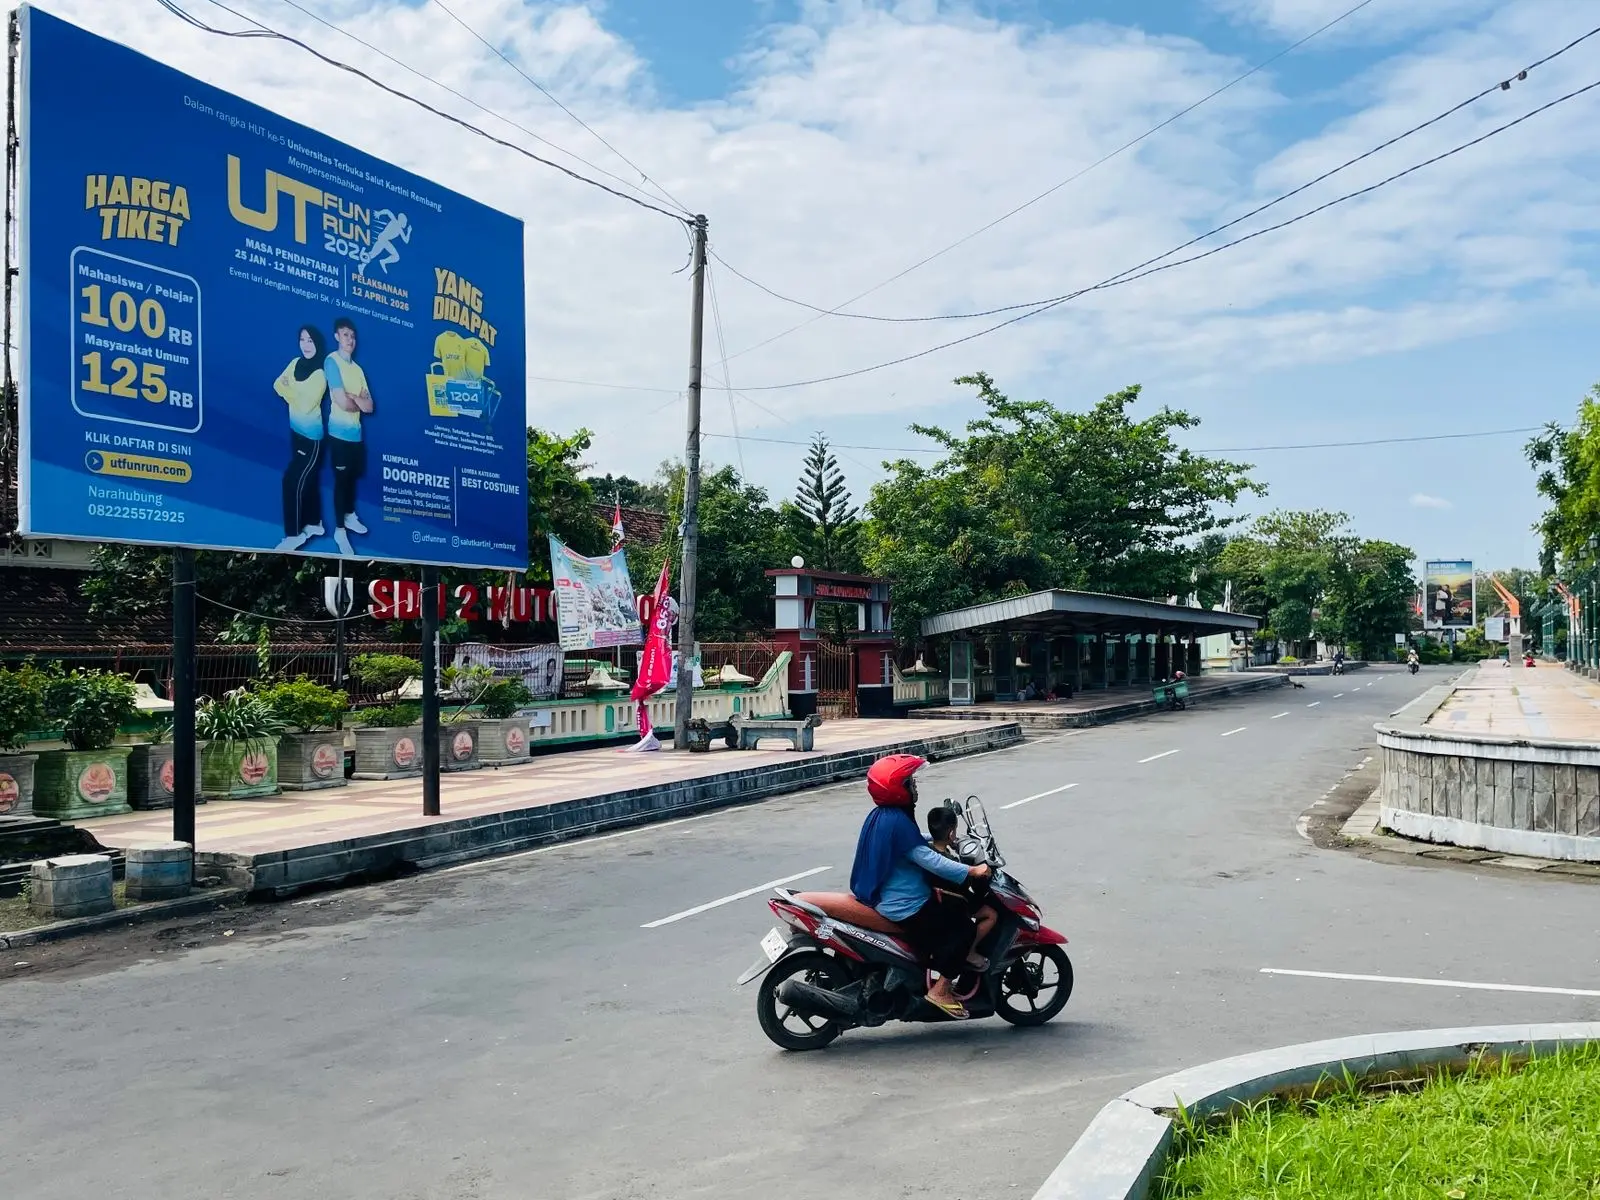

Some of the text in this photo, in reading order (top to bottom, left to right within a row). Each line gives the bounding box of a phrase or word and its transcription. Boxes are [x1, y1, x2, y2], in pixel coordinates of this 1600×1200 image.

[184, 96, 442, 213] Dalam rangka HUT ke-5 Universitas Terbuka Salut Kartini Rembang
[288, 155, 364, 195] Mempersembahkan
[85, 174, 191, 221] HARGA
[227, 153, 323, 245] UT
[323, 192, 371, 226] FUN
[99, 207, 184, 247] TIKET
[322, 213, 371, 246] RUN
[245, 238, 339, 276] MASA PENDAFTARAN
[323, 233, 371, 265] 2026
[78, 264, 194, 304] Mahasiswa / Pelajar
[229, 266, 250, 280] Event
[251, 271, 263, 283] lari
[264, 276, 290, 293] dengan
[291, 284, 319, 301] kategori
[320, 294, 330, 303] 5K
[335, 299, 341, 307] 5
[234, 249, 248, 260] 25
[249, 252, 266, 267] JAN
[274, 260, 285, 273] 12
[287, 263, 317, 283] MARET
[318, 274, 339, 289] 2026
[351, 272, 409, 298] PELAKSANAAN
[352, 286, 410, 312] 12 APRIL 2026
[434, 267, 484, 314] YANG
[80, 284, 193, 346] 100 RB
[432, 295, 498, 347] DIDAPAT
[84, 333, 189, 365] Masyarakat Umum
[81, 351, 194, 409] 125 RB
[85, 431, 192, 456] KLIK DAFTAR DI SINI
[382, 453, 419, 467] KUMPULAN
[110, 457, 186, 476] utfunrun.com
[382, 466, 451, 489] DOORPRIZE
[88, 485, 164, 507] Narahubung
[461, 477, 520, 496] BEST COSTUME
[88, 503, 186, 523] 082225572925
[454, 583, 480, 621] 2
